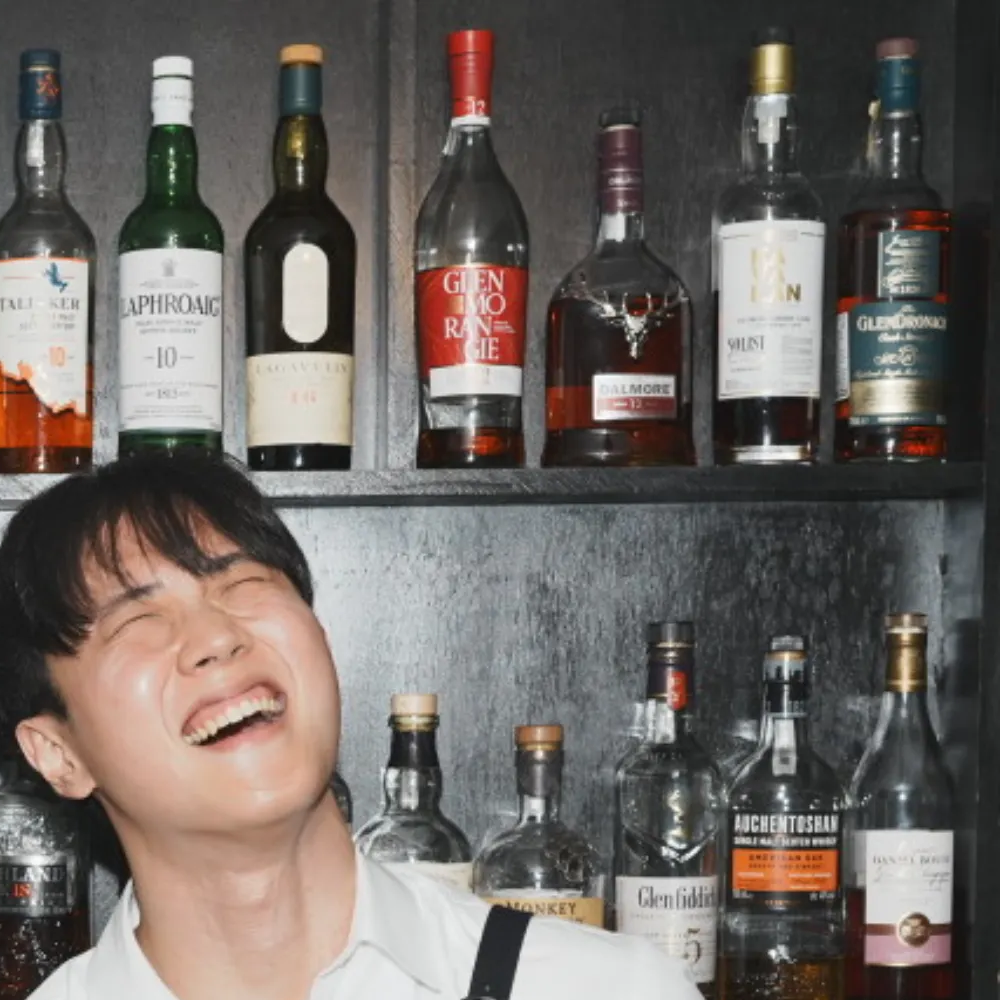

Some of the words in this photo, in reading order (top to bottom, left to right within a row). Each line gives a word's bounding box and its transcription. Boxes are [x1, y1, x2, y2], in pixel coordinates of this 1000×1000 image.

[0, 297, 80, 312] TALIKER
[120, 293, 221, 320] LAPHROAIG
[156, 346, 178, 369] 10
